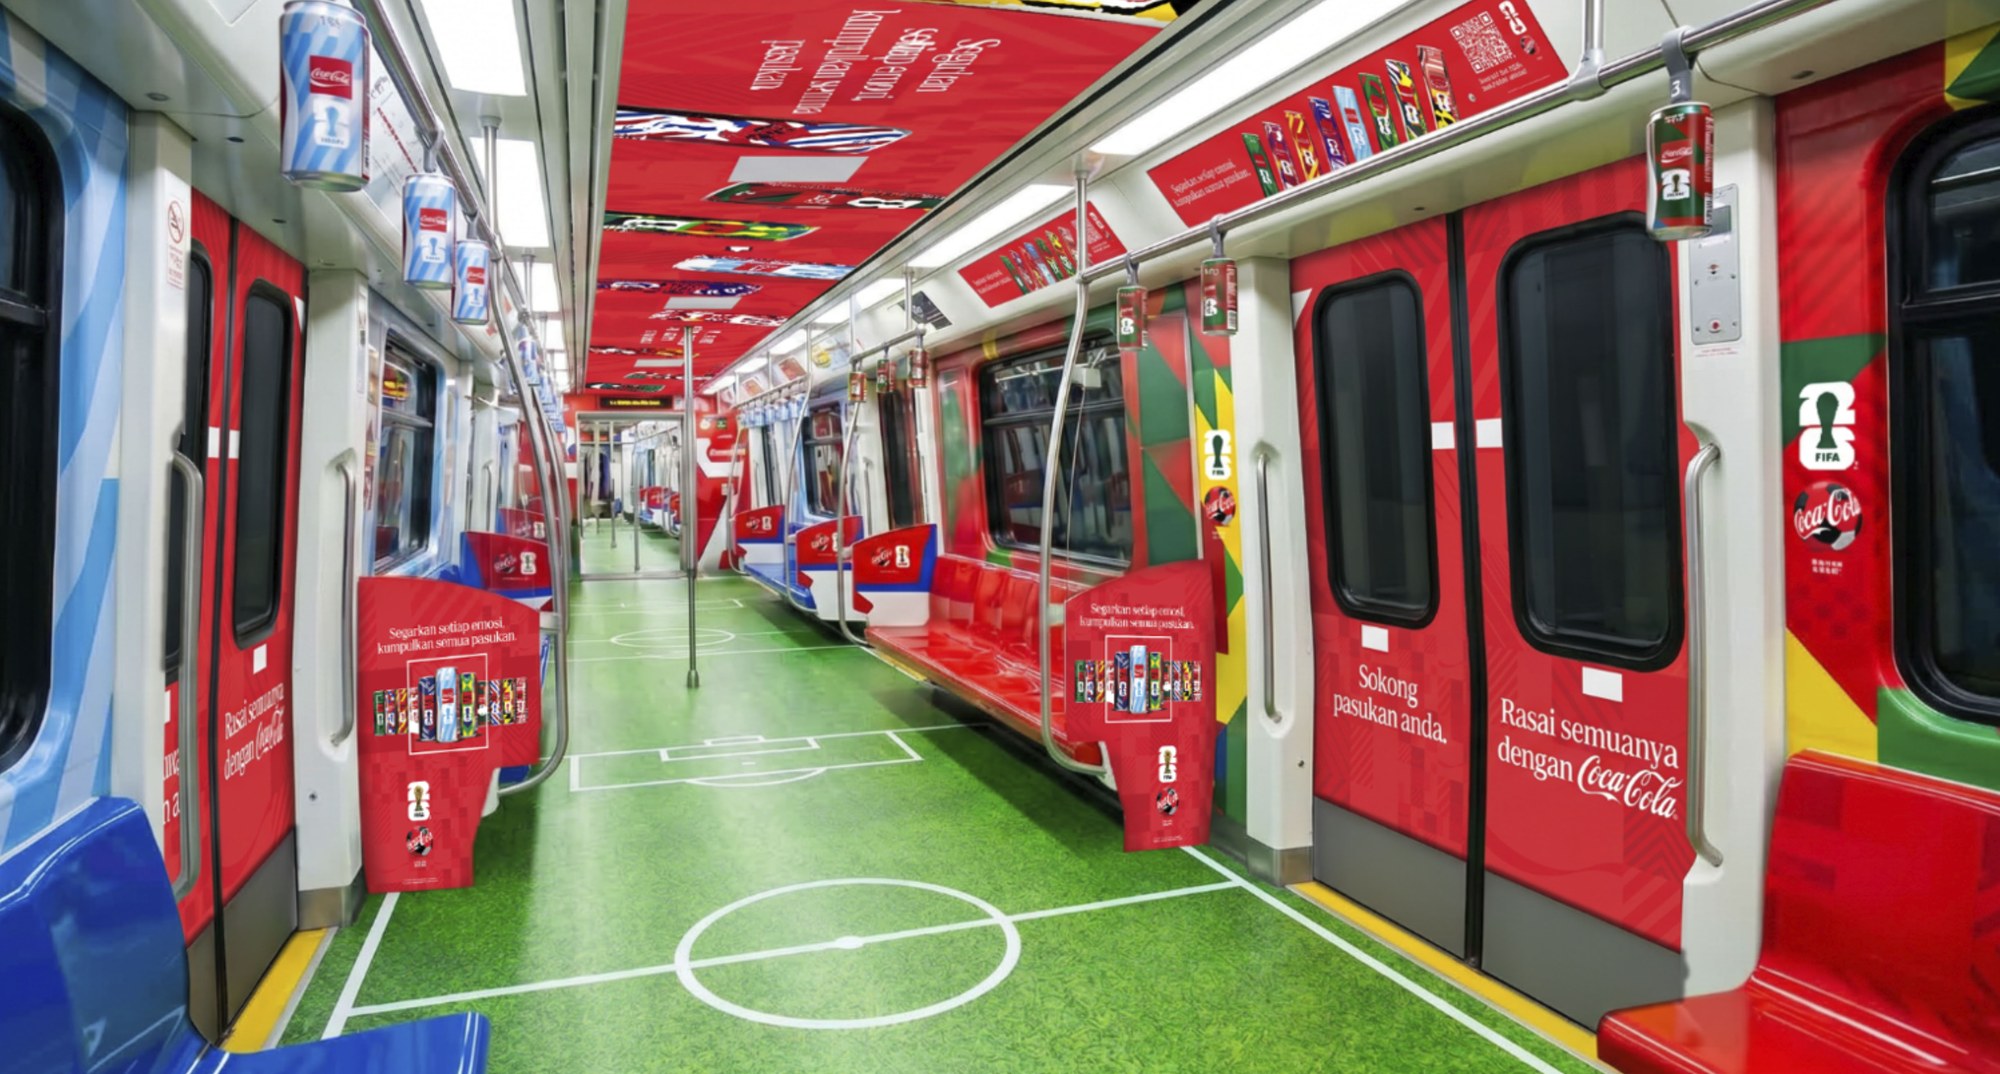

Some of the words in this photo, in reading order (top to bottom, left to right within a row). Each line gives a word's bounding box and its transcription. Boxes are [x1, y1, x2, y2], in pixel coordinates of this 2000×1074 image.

[1671, 80, 1681, 98] 3
[1815, 453, 1841, 462] FIFA
[376, 637, 434, 656] kumpulkan
[388, 624, 437, 641] Segarkan
[1358, 664, 1419, 709] Sokong
[224, 698, 248, 740] Rasai
[1333, 693, 1399, 730] pasukan
[1400, 710, 1448, 744] anda.
[1500, 697, 1556, 737] Rasai
[1561, 716, 1680, 770] semuanya
[1498, 737, 1574, 783] dengan
